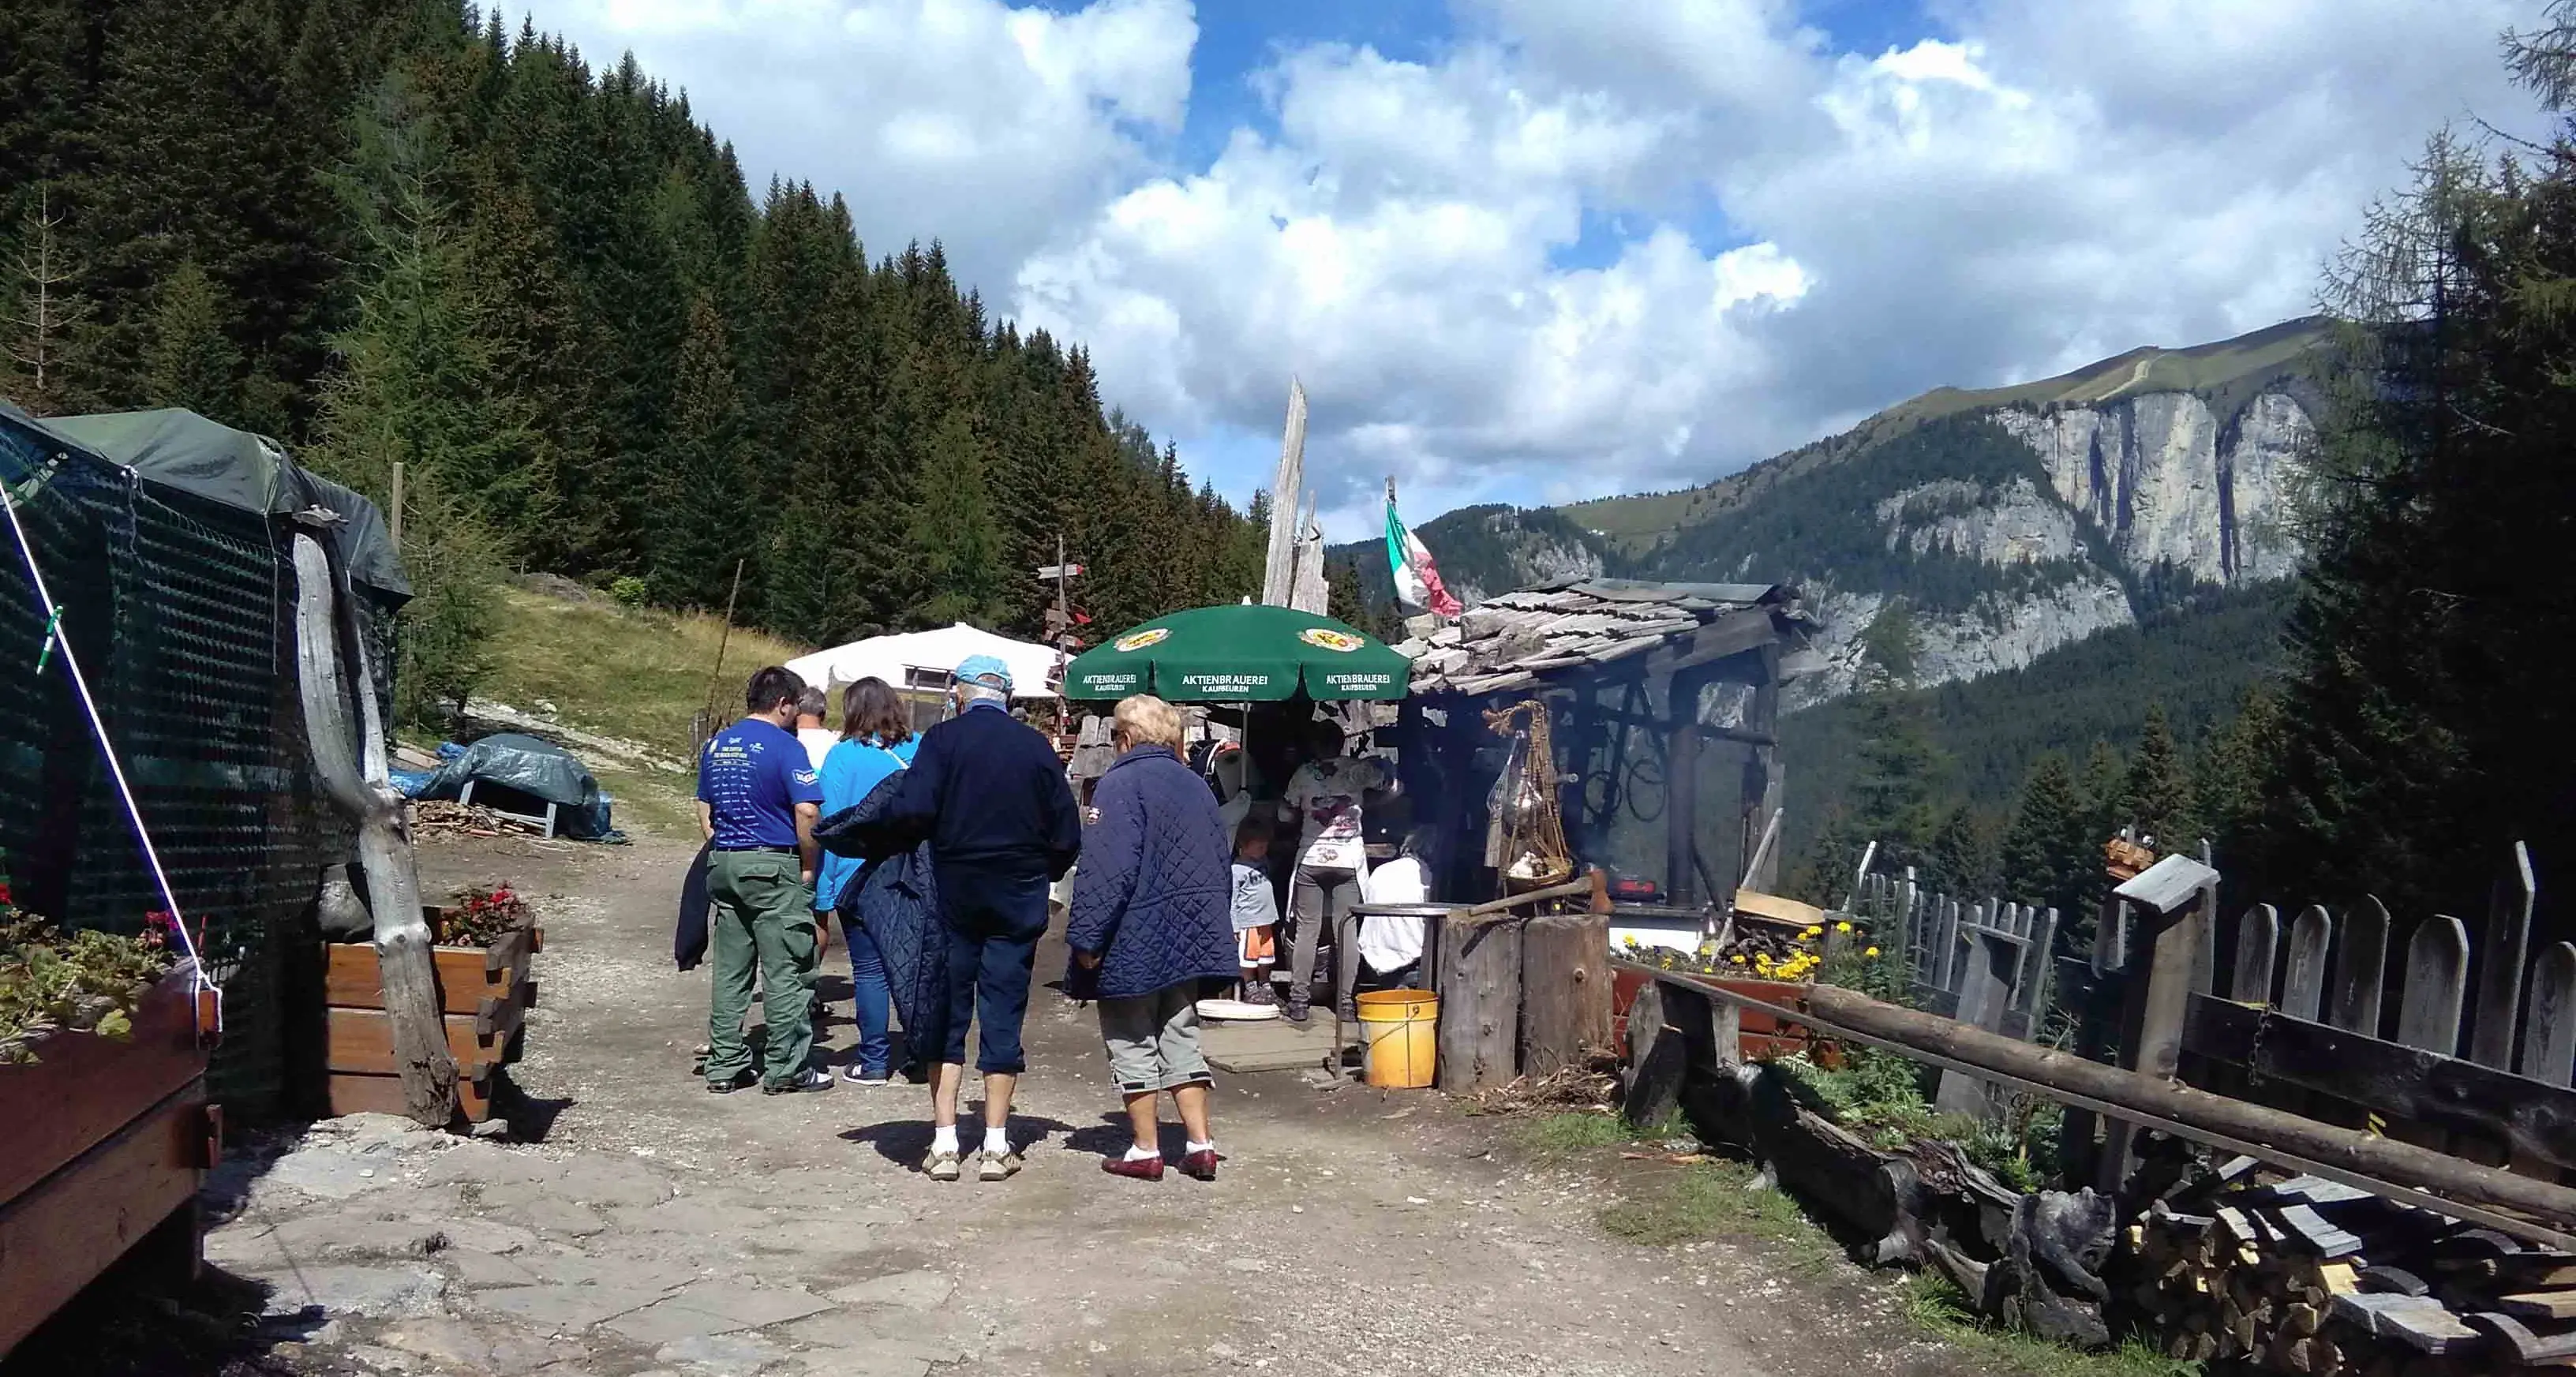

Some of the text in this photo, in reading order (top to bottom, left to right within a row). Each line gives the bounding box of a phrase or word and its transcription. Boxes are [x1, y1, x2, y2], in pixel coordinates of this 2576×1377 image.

[1083, 674, 1136, 684] AKTIENBRAUEREI
[1182, 675, 1268, 685] AKTIENBRAUEREI
[1326, 674, 1391, 684] AKTIENBRAUEREI
